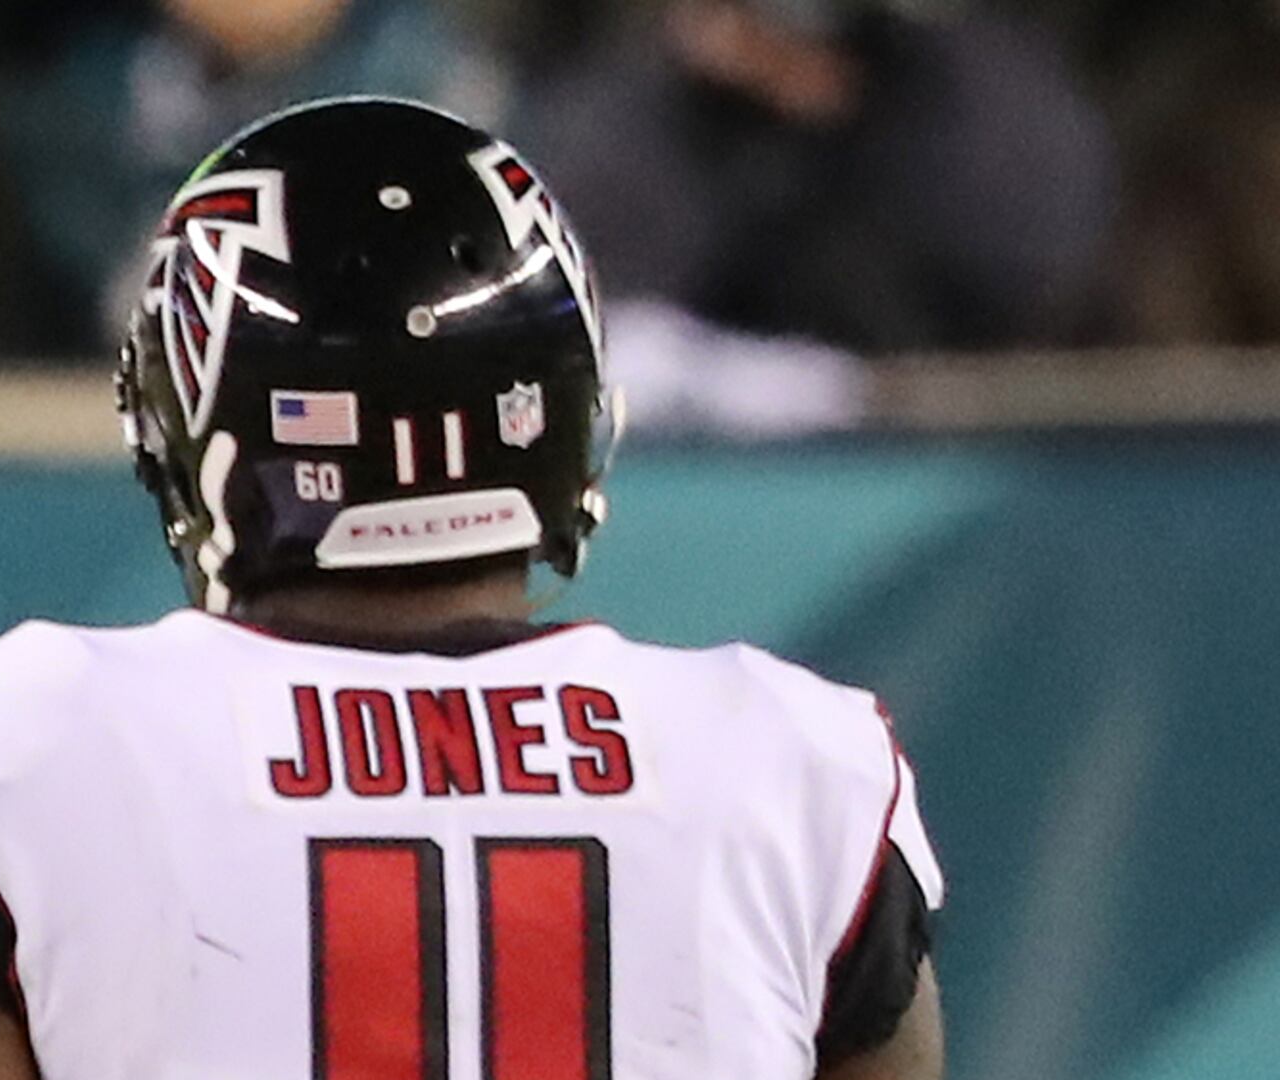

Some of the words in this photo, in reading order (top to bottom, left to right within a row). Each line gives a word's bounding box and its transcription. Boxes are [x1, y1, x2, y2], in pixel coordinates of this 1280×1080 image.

[392, 410, 465, 486] 11
[293, 459, 344, 501] 60
[350, 508, 515, 538] FALCONS
[267, 684, 635, 797] JONES
